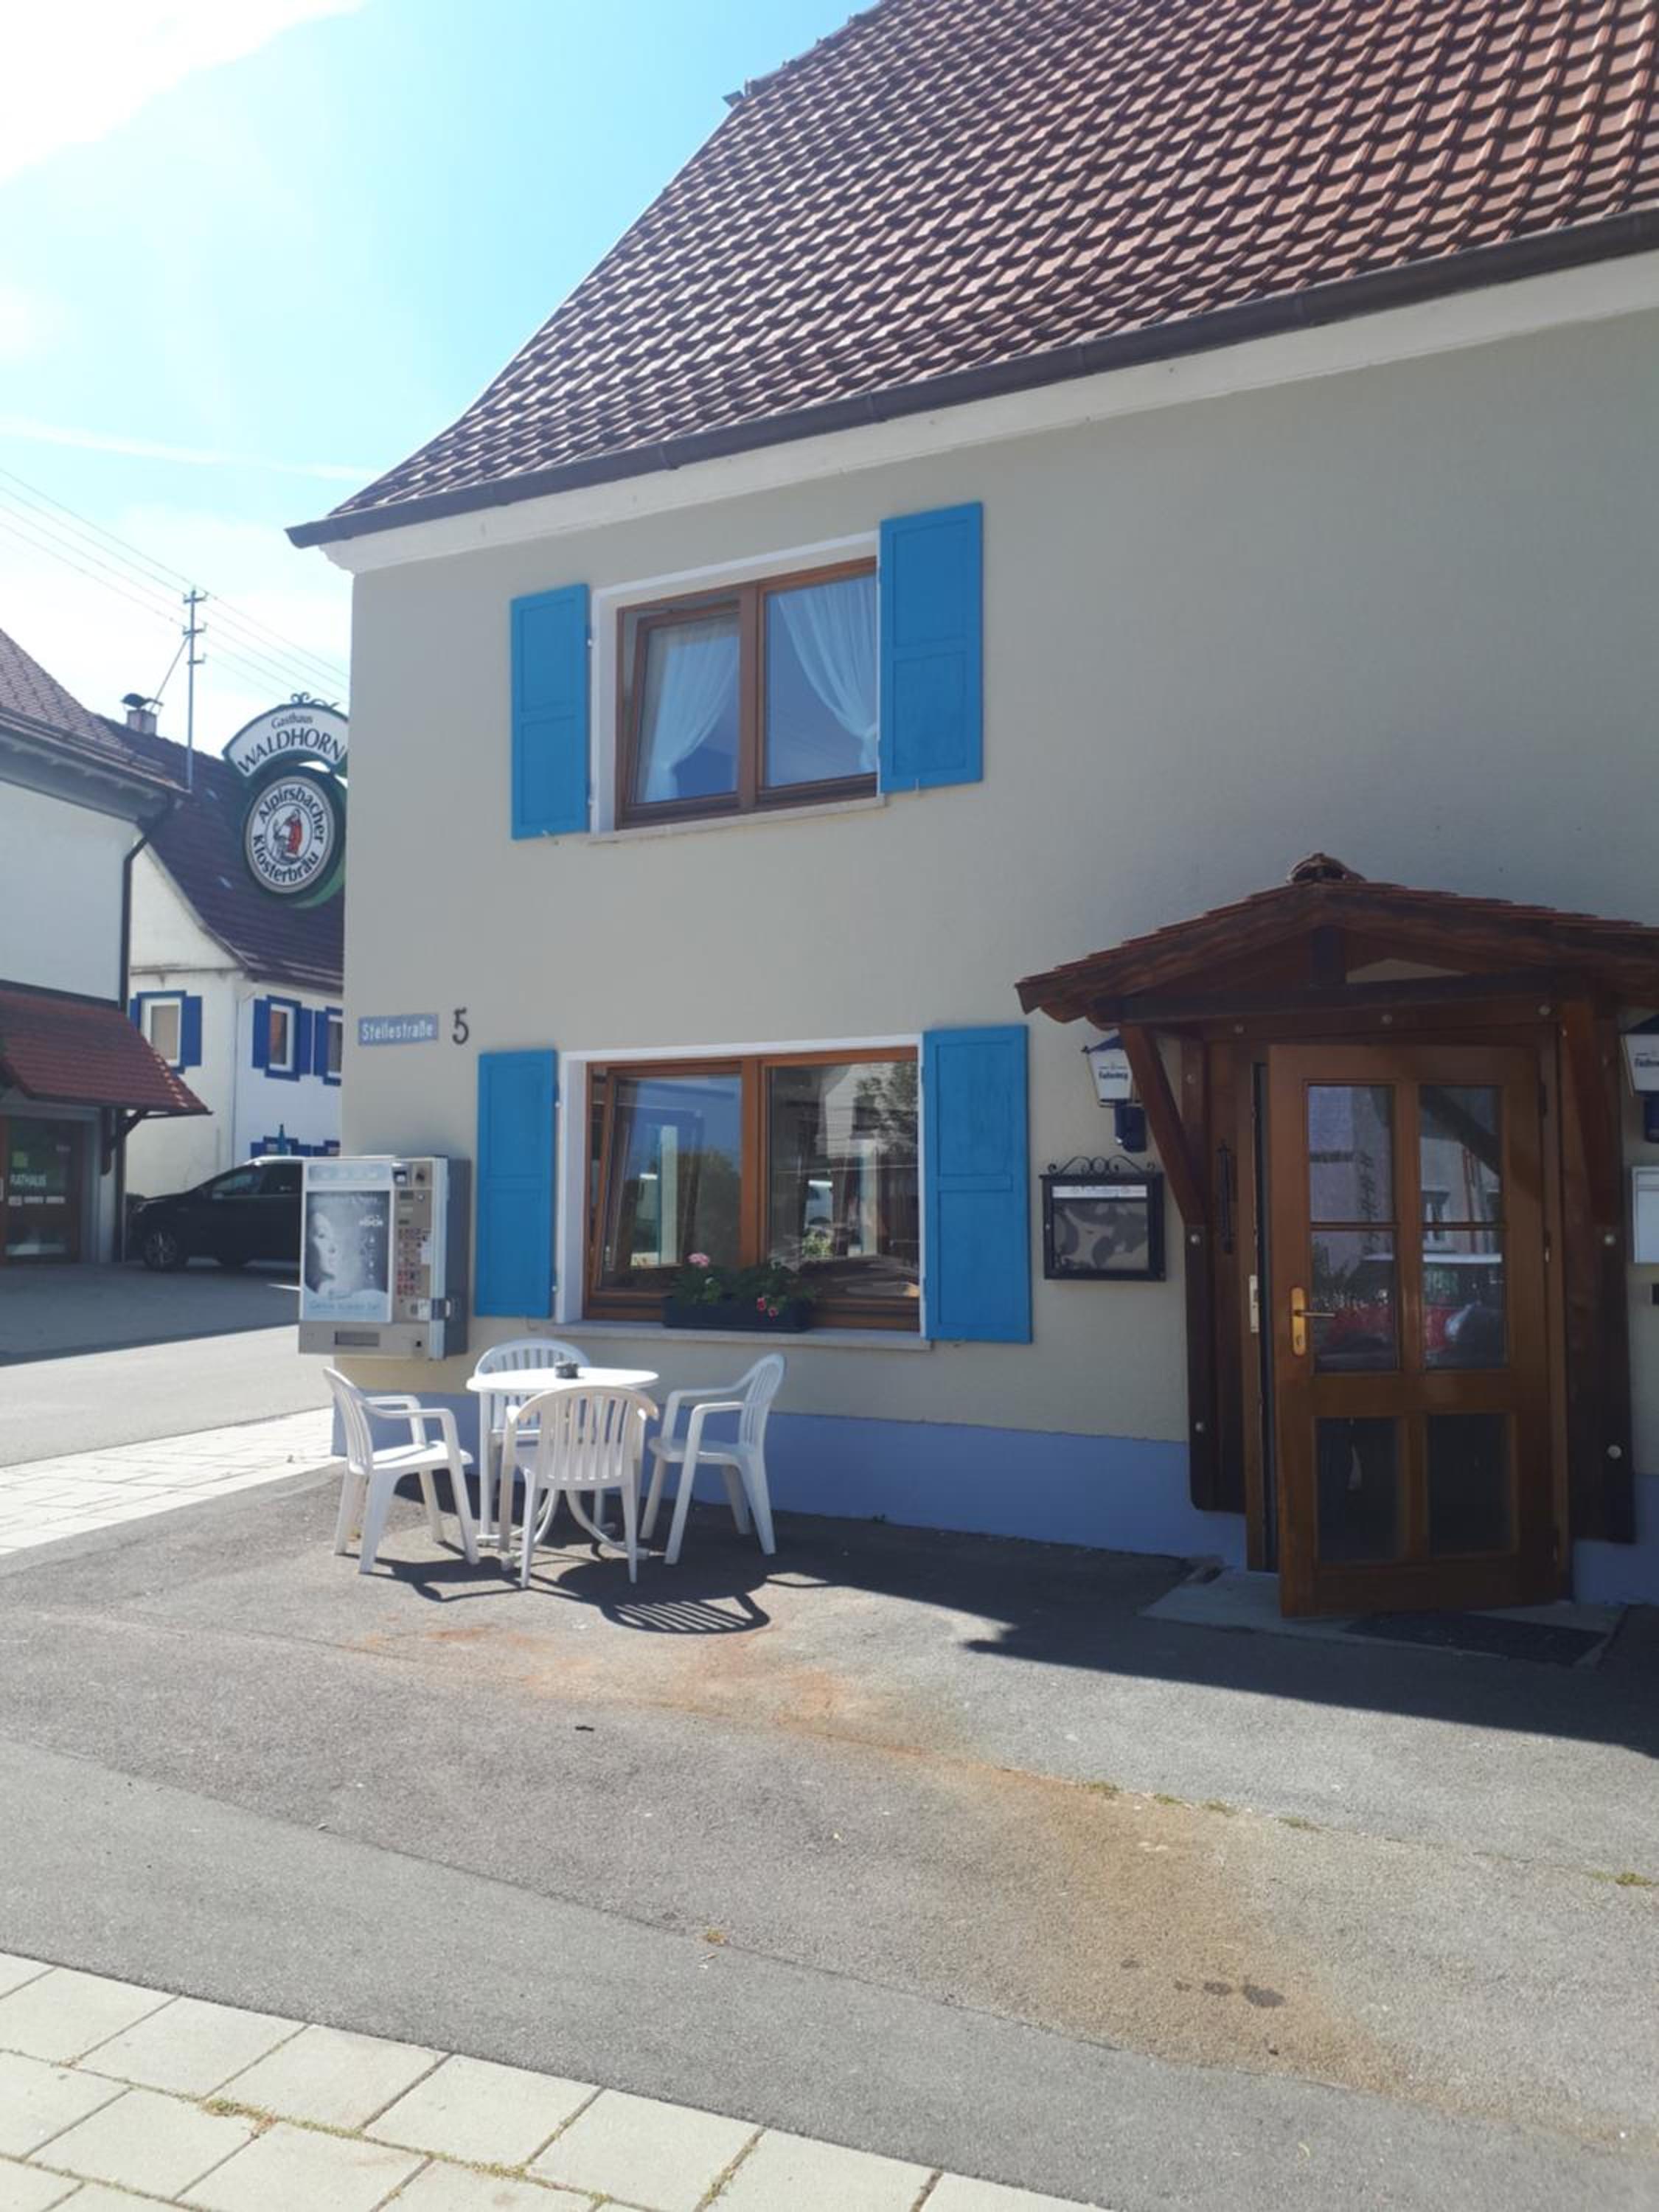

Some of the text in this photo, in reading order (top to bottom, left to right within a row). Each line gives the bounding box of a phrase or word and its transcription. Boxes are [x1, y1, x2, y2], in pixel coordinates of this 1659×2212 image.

[271, 712, 313, 730] Gasthaus
[237, 727, 345, 774] WALDHORN
[258, 786, 324, 845] Alpirsbacher
[253, 833, 319, 883] Klosterbräu
[452, 1006, 469, 1045] 5
